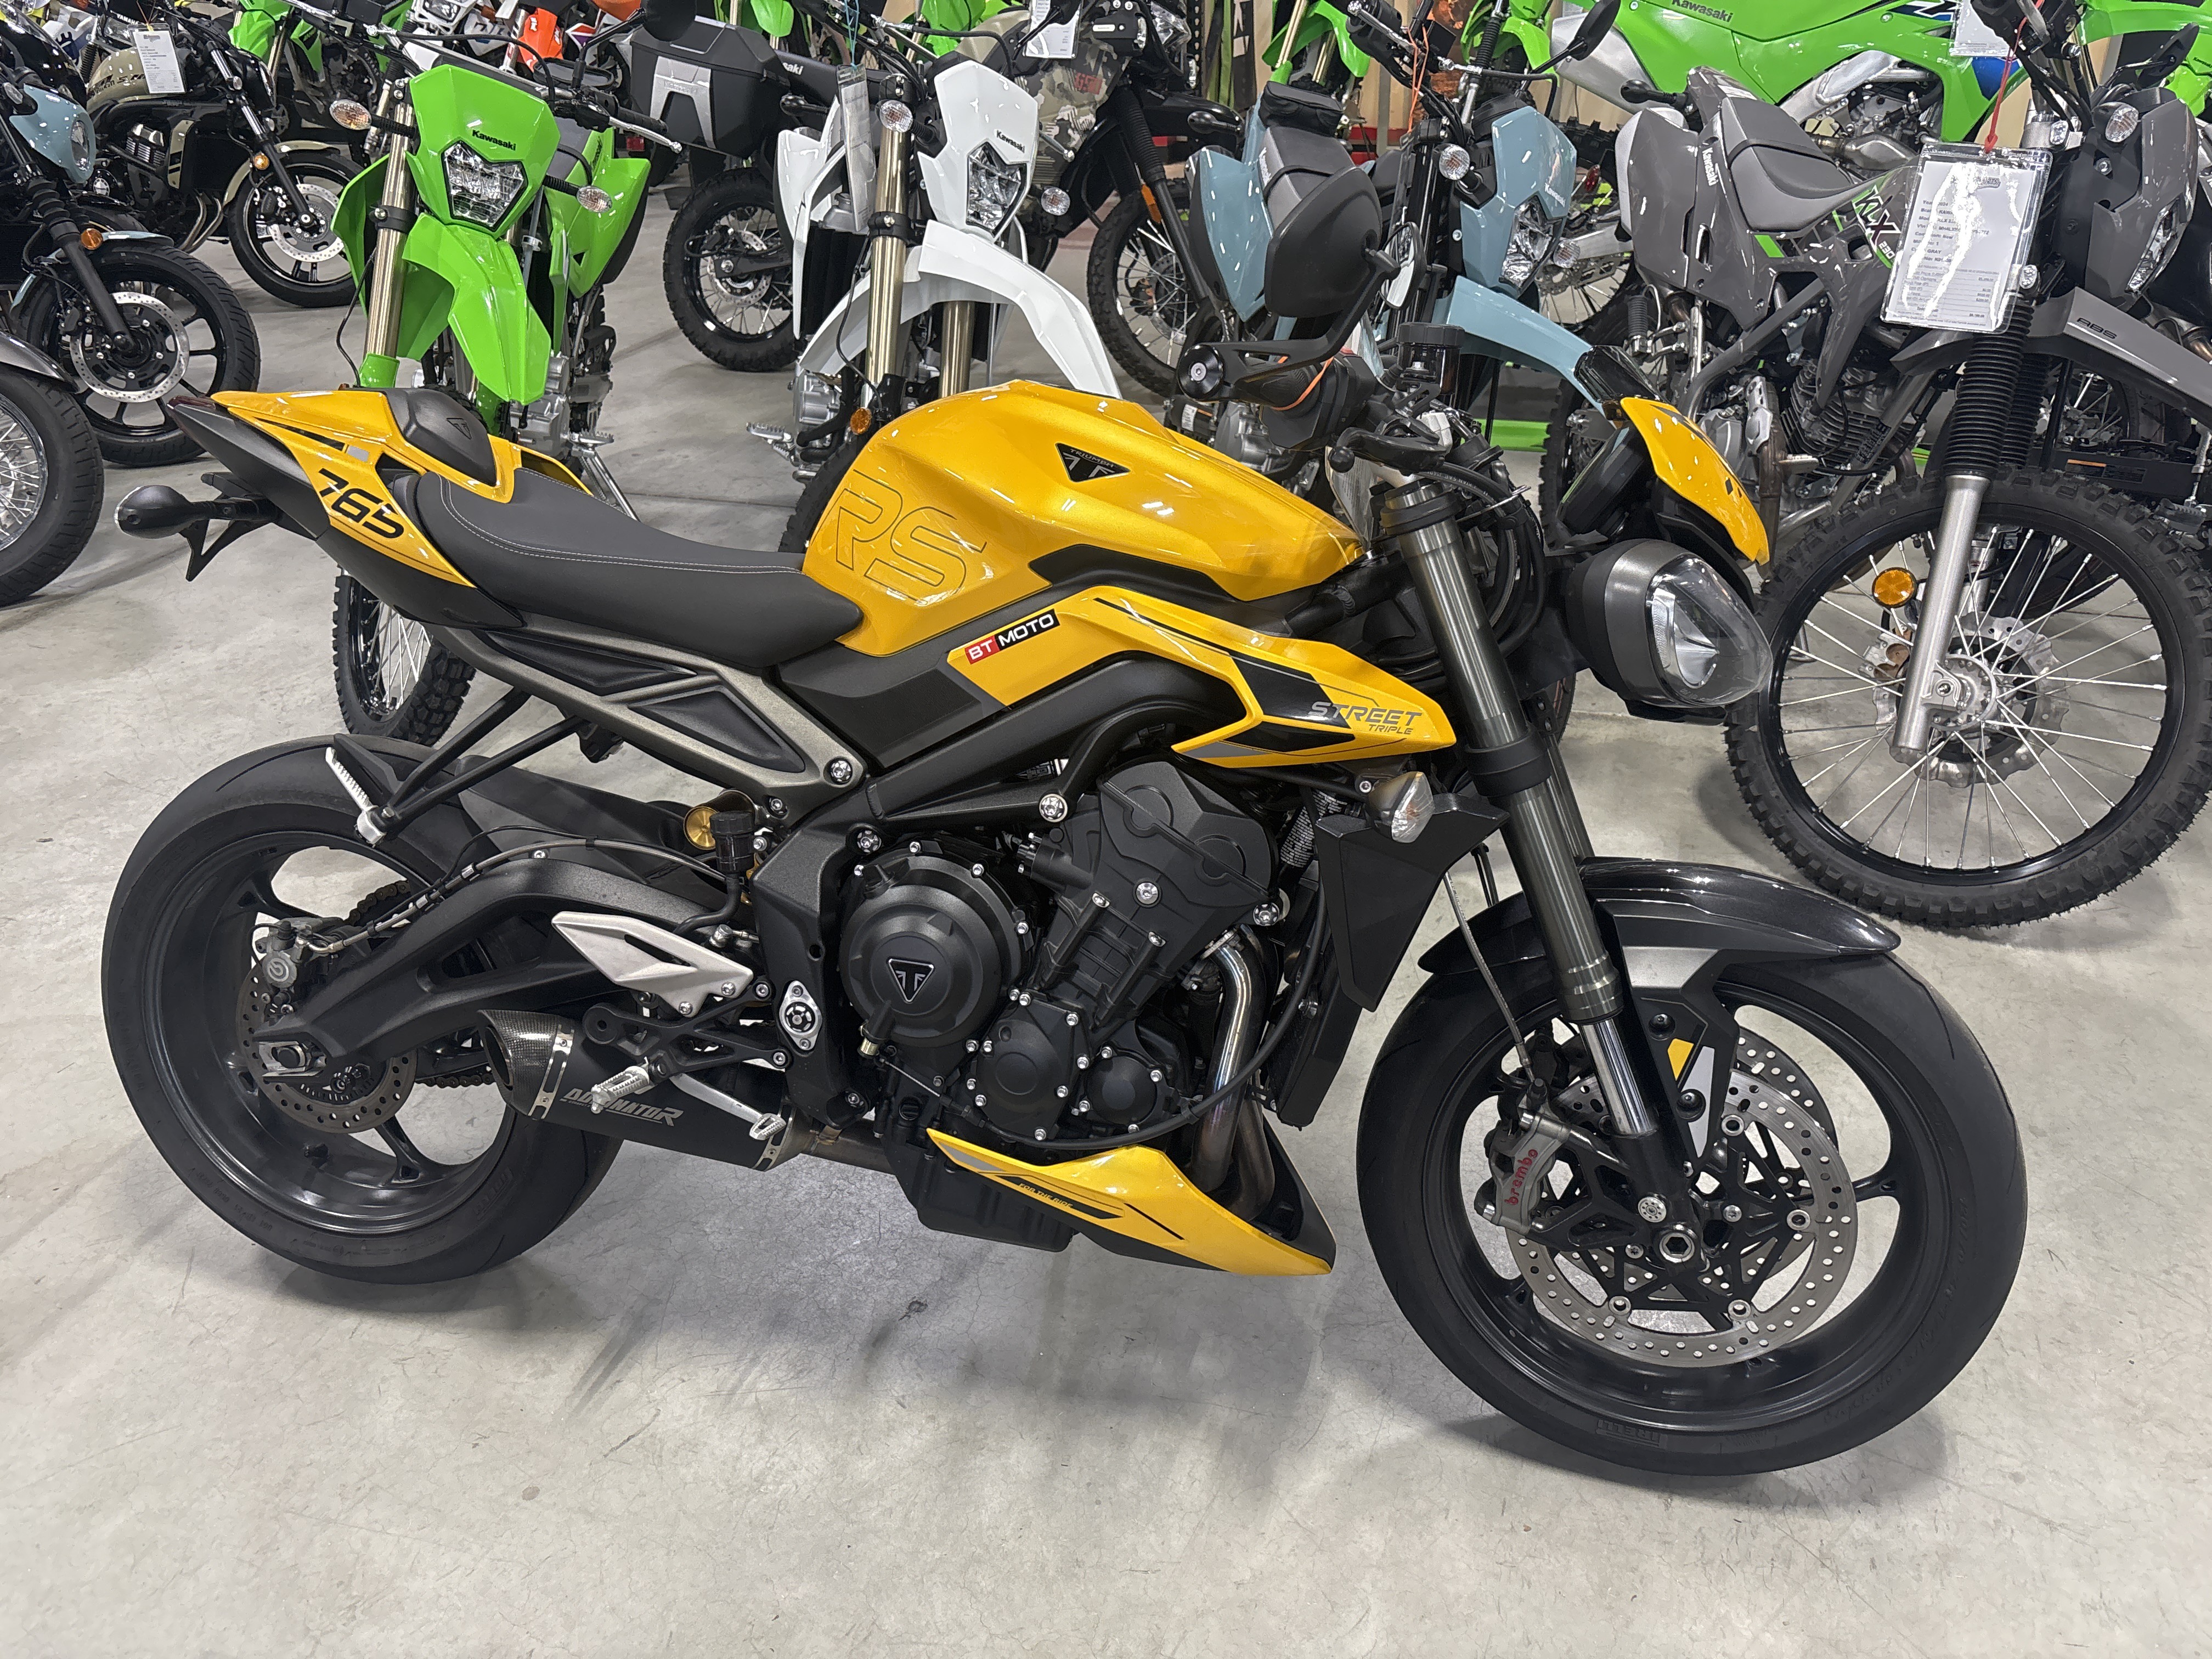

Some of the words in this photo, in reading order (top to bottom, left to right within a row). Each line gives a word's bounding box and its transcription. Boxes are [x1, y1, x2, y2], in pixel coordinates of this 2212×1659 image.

[1672, 0, 1733, 22] Kawasaki
[472, 129, 516, 151] Kawasaki
[996, 129, 1025, 154] Kawasaki
[1702, 147, 1719, 186] Kawasaki
[1878, 241, 1895, 259] 230
[2076, 317, 2118, 340] ABS
[1070, 448, 1114, 468] TRIUMPH
[318, 467, 404, 539] 765
[810, 469, 987, 607] RS
[968, 639, 992, 661] BT
[998, 613, 1054, 647] MOTO
[1307, 701, 1423, 726] STREET
[1368, 724, 1414, 735] TRIPLE
[1504, 1149, 1538, 1205] brembo
[1019, 1183, 1036, 1194] FOR
[1036, 1190, 1053, 1200] THE
